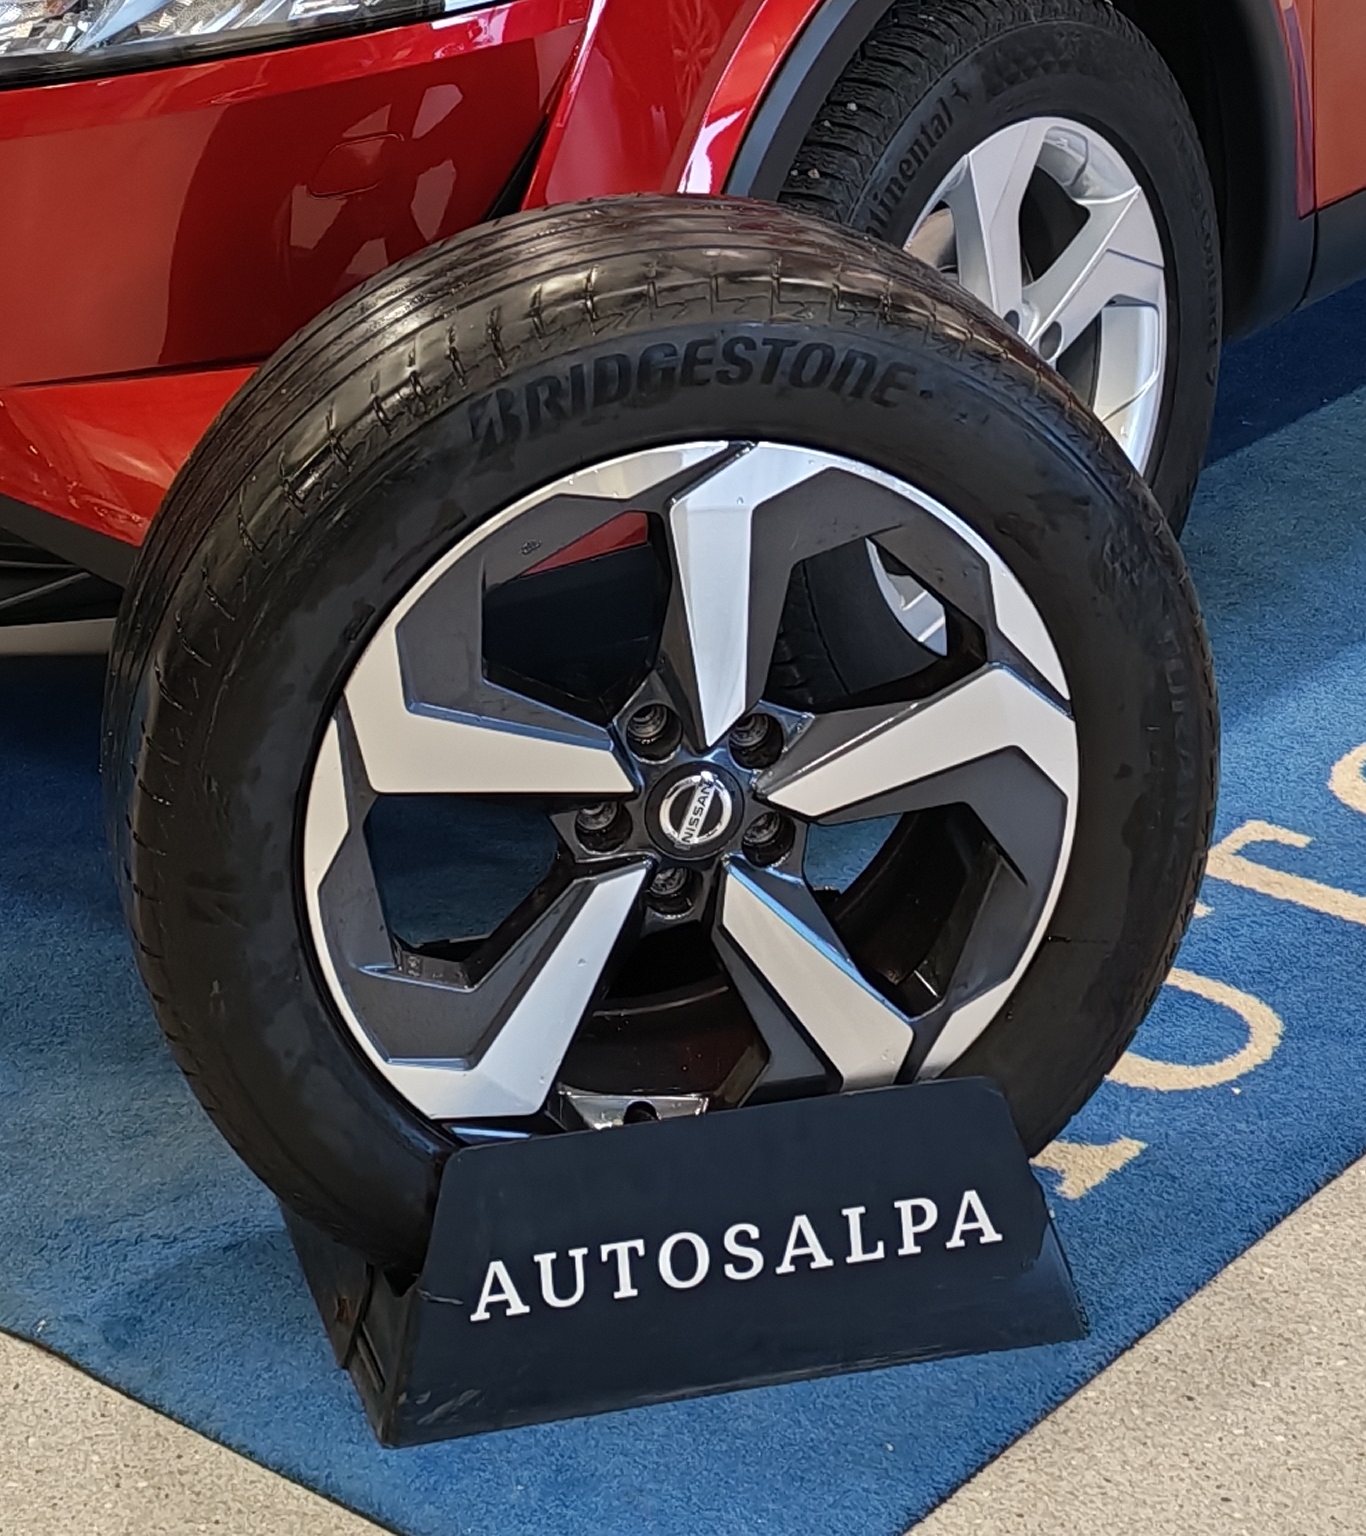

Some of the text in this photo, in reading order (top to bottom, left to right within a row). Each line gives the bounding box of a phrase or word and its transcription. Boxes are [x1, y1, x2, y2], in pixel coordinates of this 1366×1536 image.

[465, 336, 918, 462] BRIDGESTONE
[681, 778, 714, 844] NISSAN
[470, 1189, 1003, 1322] AUTOSALPA
